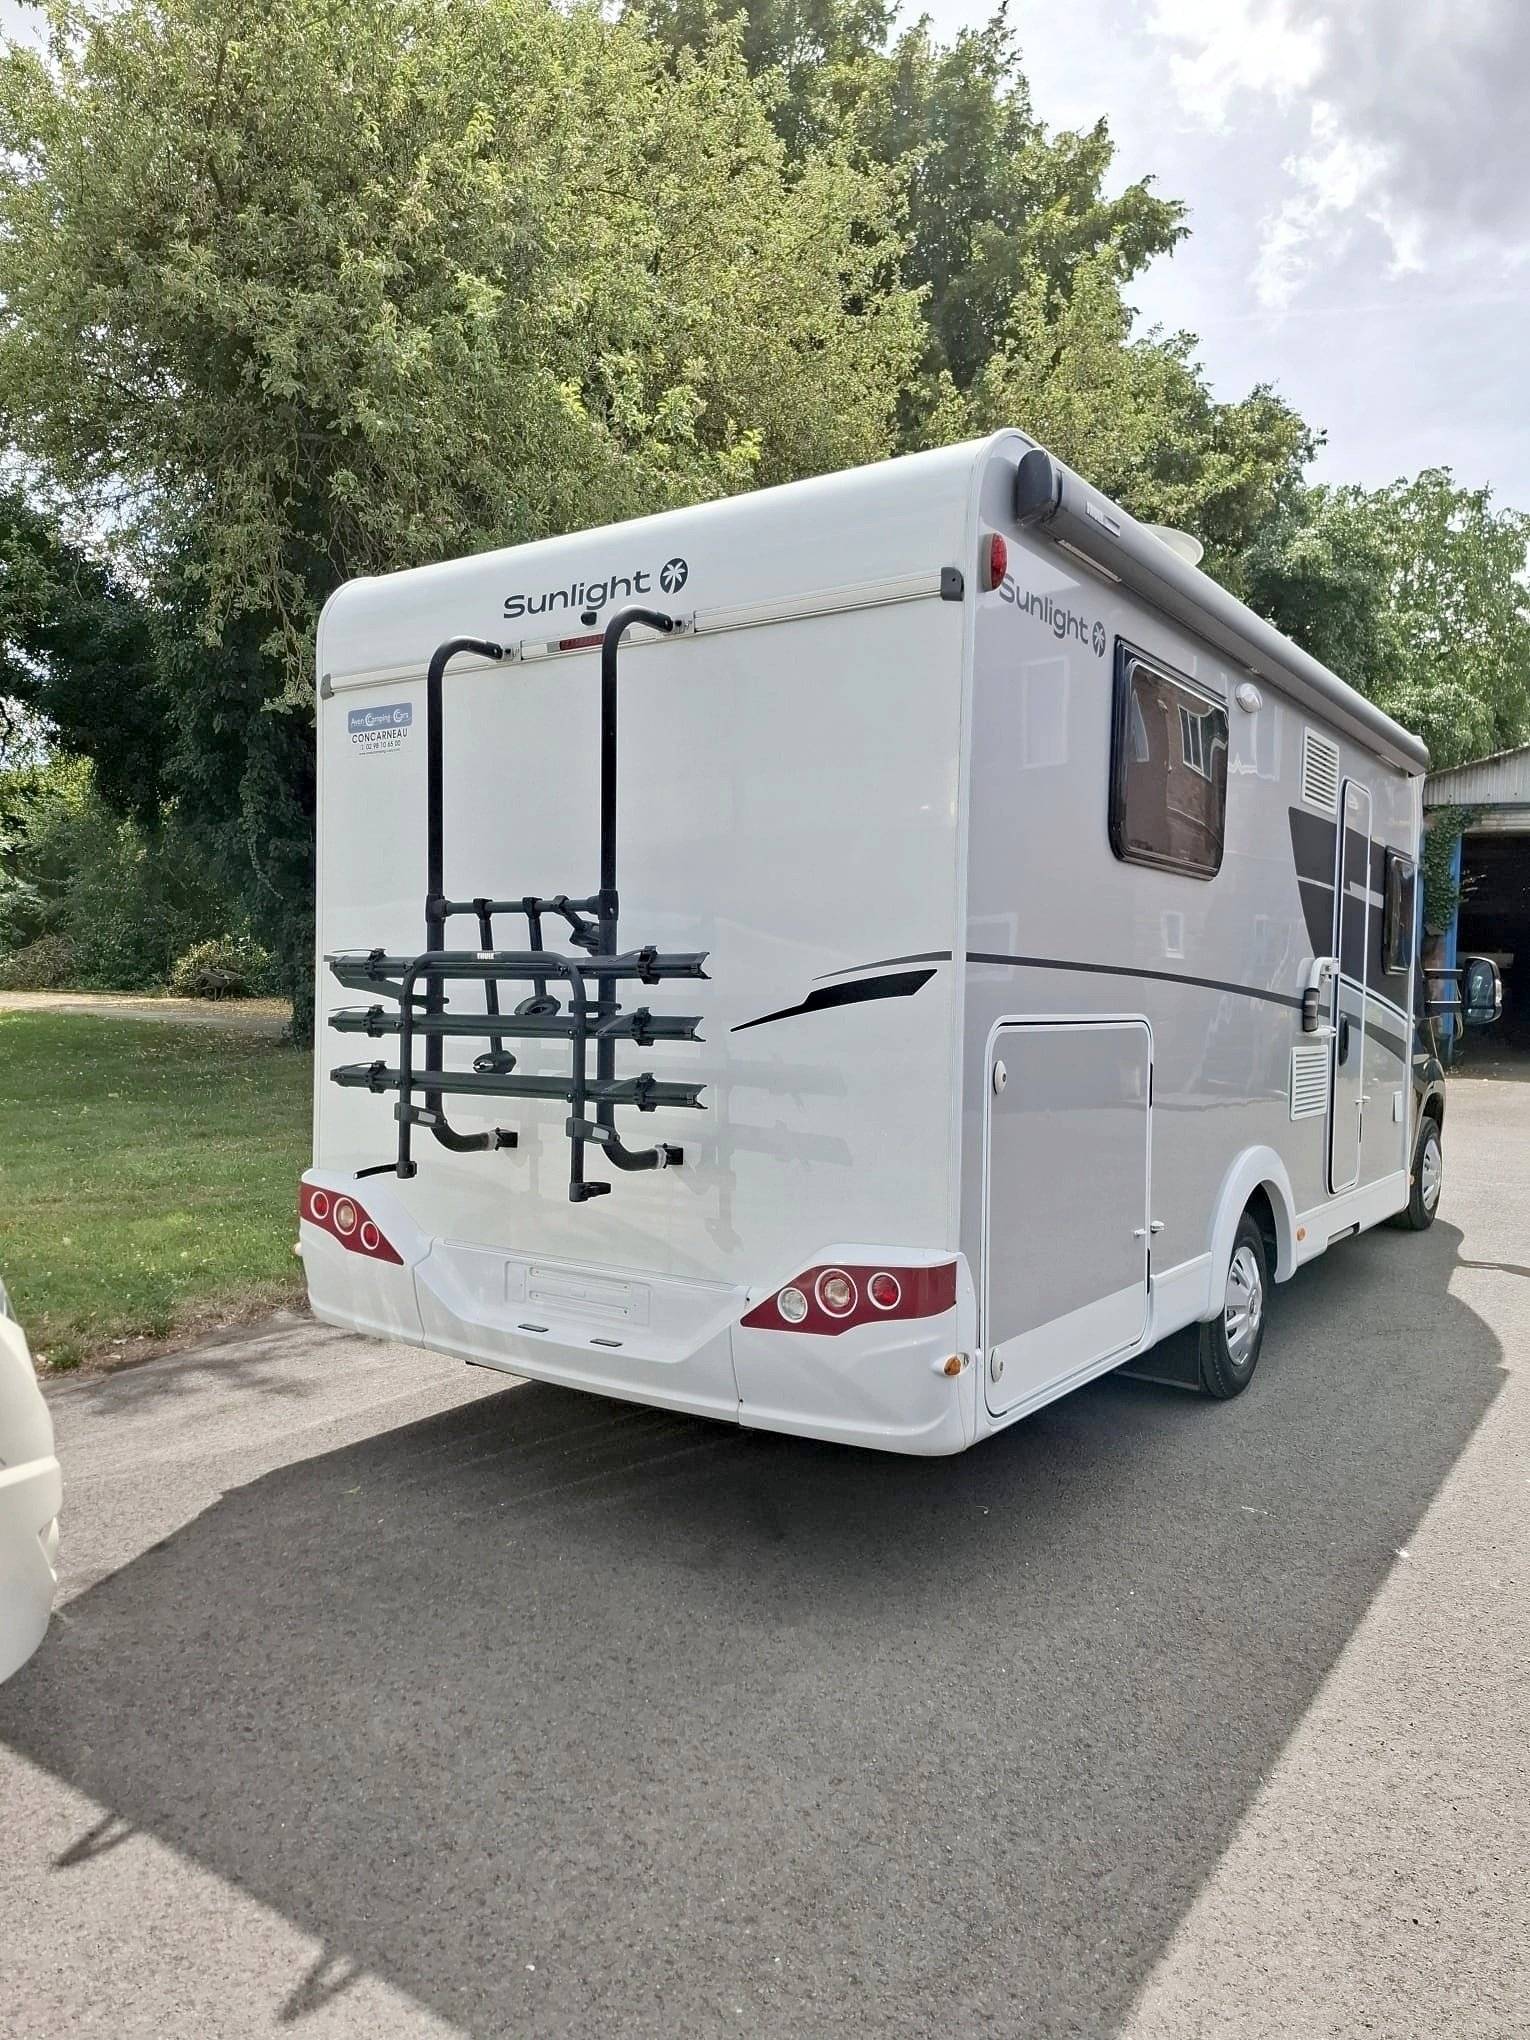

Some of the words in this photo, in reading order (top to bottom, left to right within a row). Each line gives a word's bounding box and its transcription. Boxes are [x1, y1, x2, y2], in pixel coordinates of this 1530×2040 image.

[503, 571, 651, 619] Sunlight
[999, 573, 1088, 645] Sunlight
[351, 728, 408, 744] CONCARNEAU
